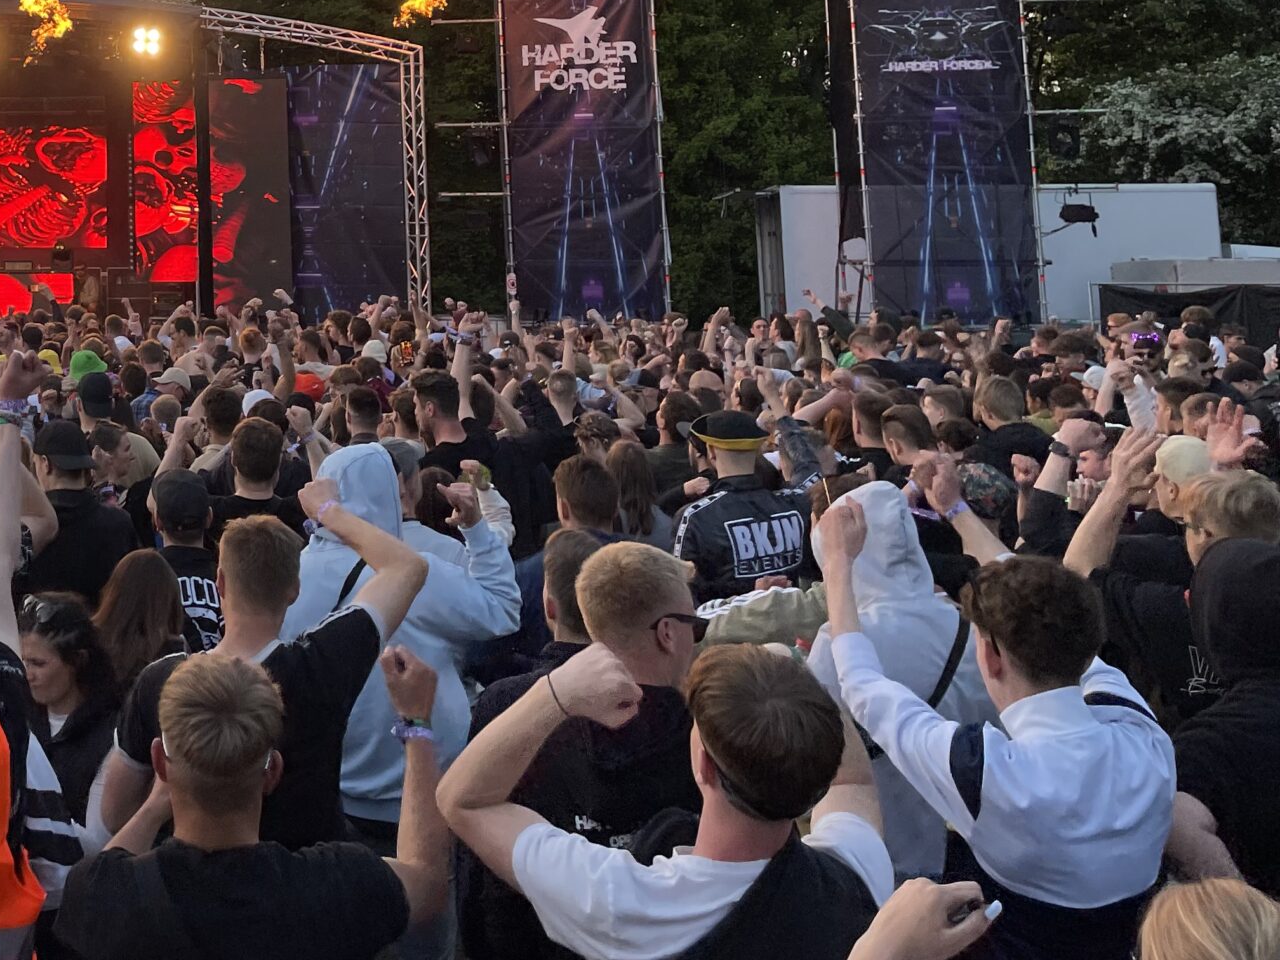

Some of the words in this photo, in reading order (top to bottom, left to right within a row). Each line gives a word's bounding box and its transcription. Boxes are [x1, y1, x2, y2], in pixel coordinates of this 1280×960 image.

[521, 40, 638, 67] HARDER
[886, 60, 939, 73] HARDER
[534, 67, 627, 94] FORCE
[732, 515, 801, 560] BKJN
[738, 547, 802, 574] EVENTS
